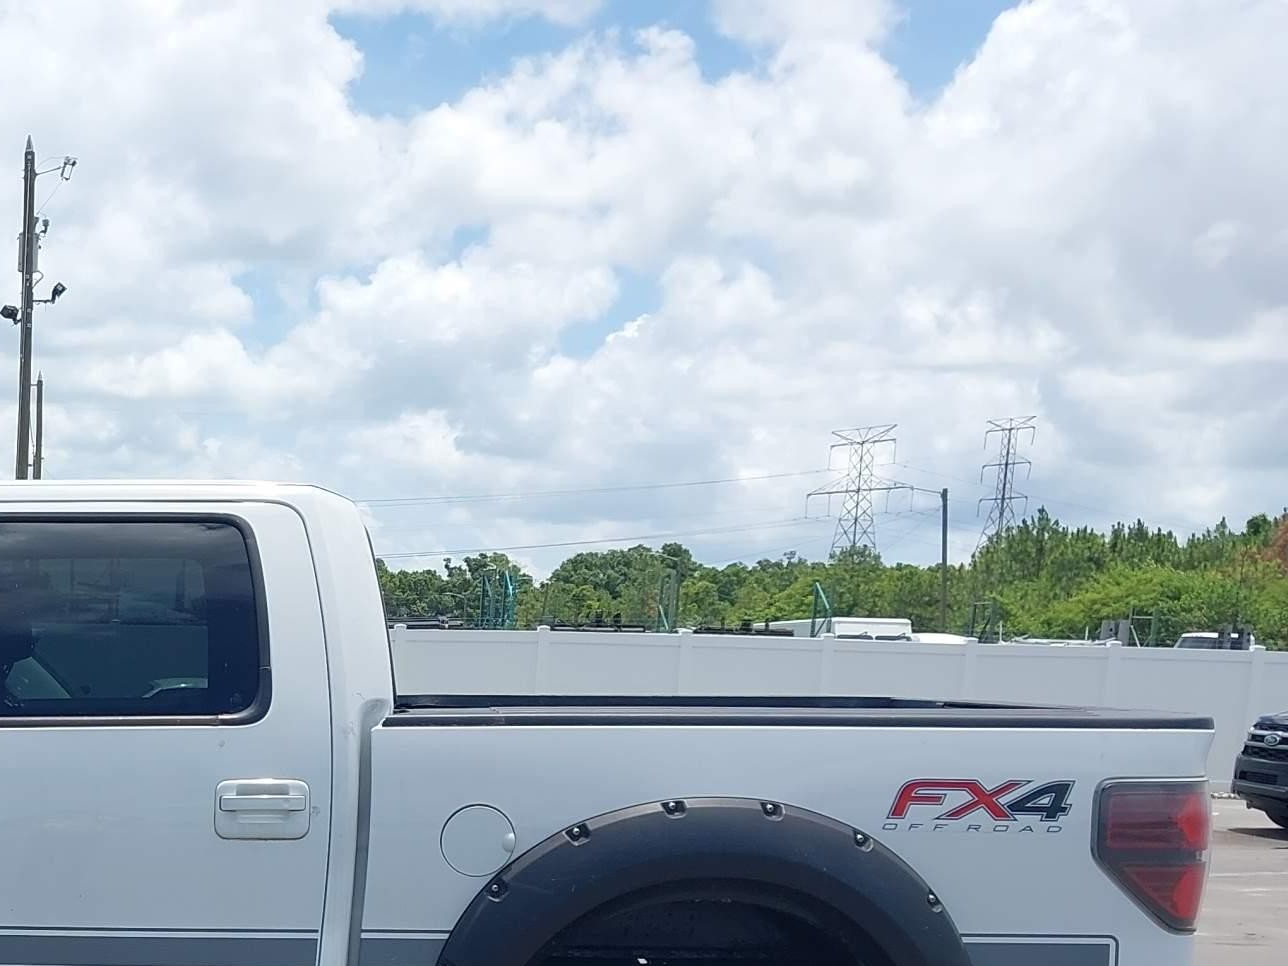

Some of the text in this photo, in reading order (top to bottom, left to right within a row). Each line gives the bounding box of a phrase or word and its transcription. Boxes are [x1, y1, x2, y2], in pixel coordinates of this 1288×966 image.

[887, 779, 1076, 822] FX4
[881, 823, 1063, 834] OFF ROAD
